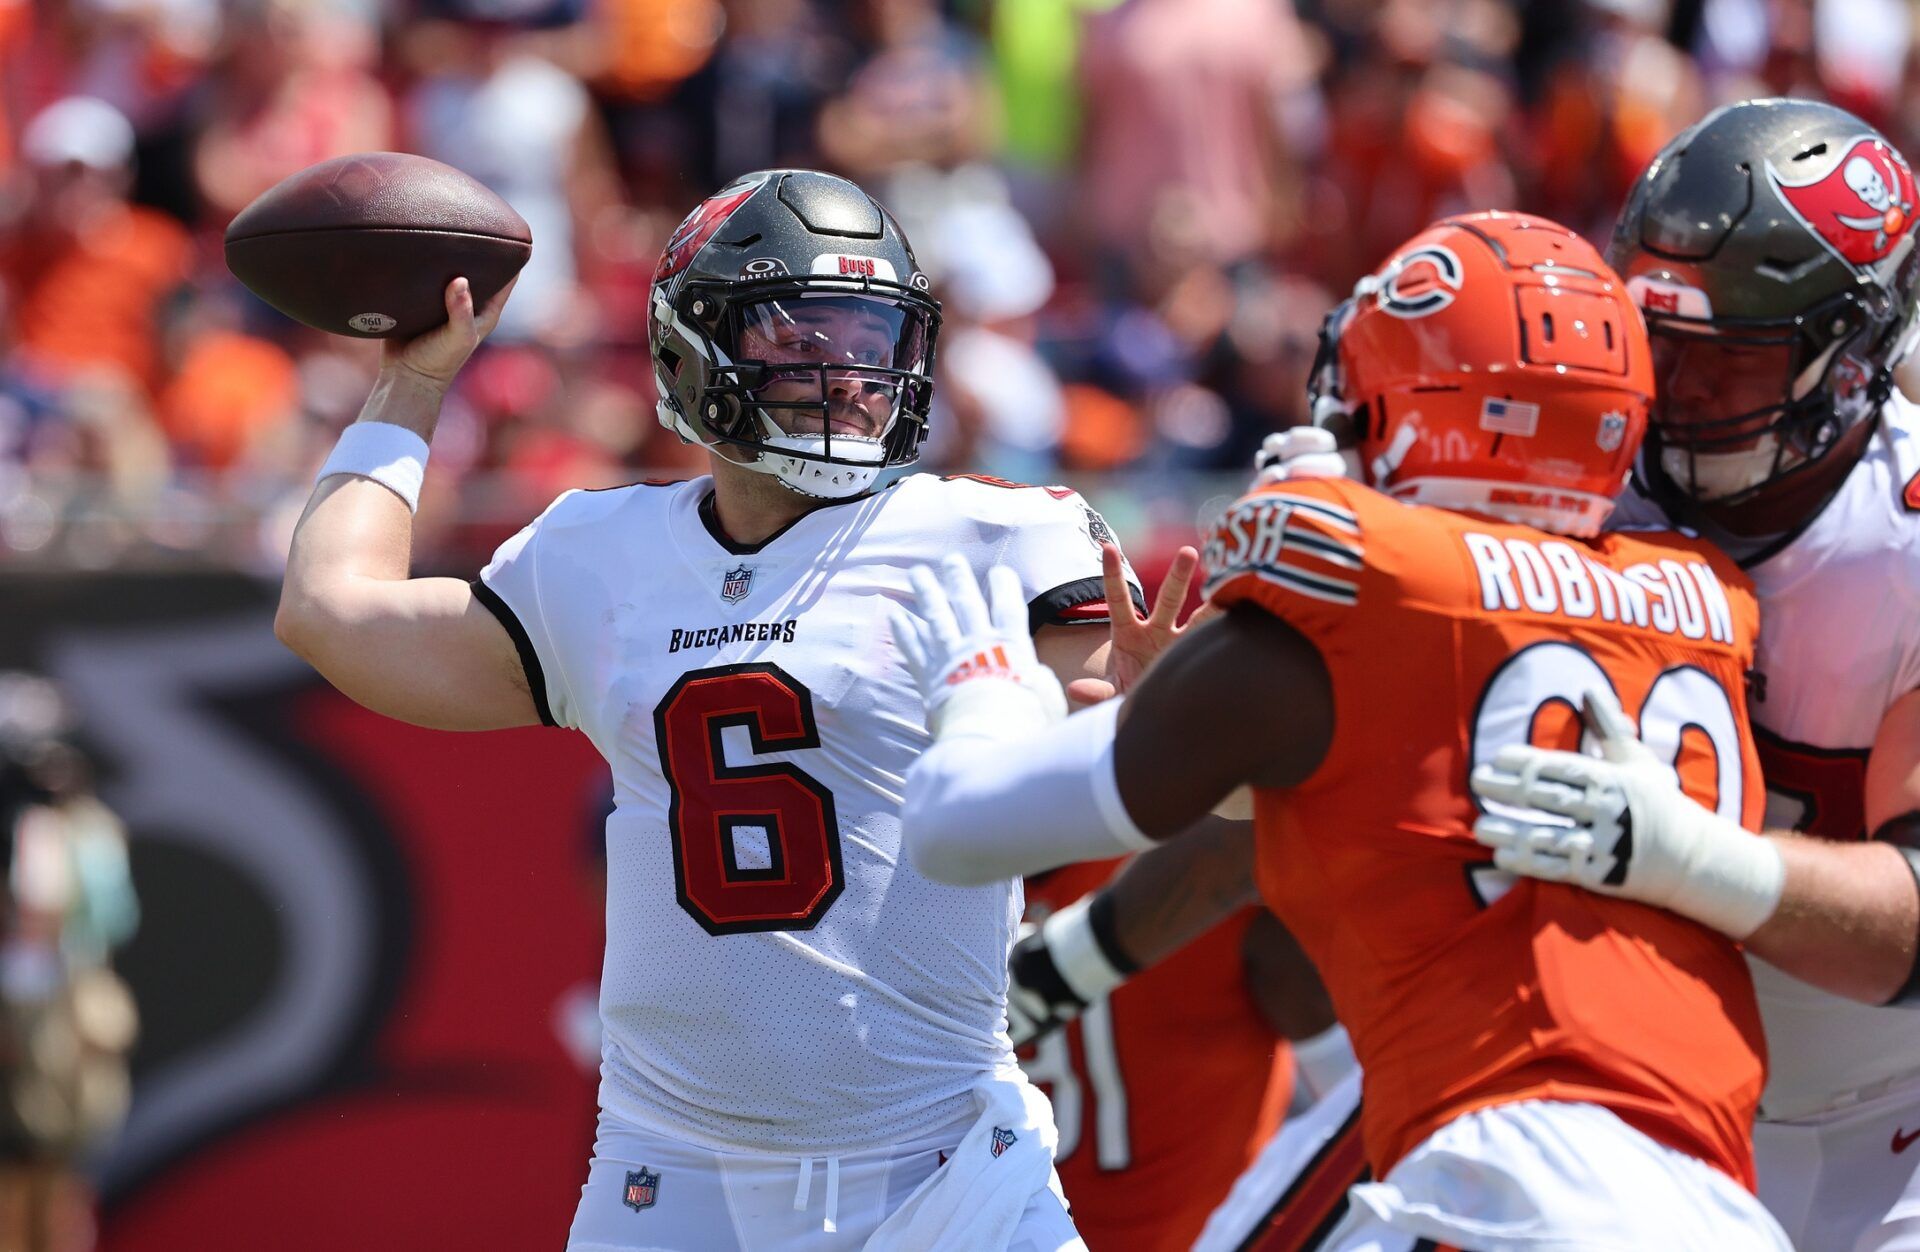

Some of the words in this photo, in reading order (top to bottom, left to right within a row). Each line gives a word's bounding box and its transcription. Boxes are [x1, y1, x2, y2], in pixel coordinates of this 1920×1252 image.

[740, 271, 783, 281] OAKLEY
[838, 256, 875, 277] BUCS
[724, 580, 746, 596] NFL
[1463, 532, 1735, 645] ROBINSON
[668, 619, 797, 653] BUCCANEERS
[653, 661, 845, 937] 6
[627, 1184, 654, 1204] NFL
